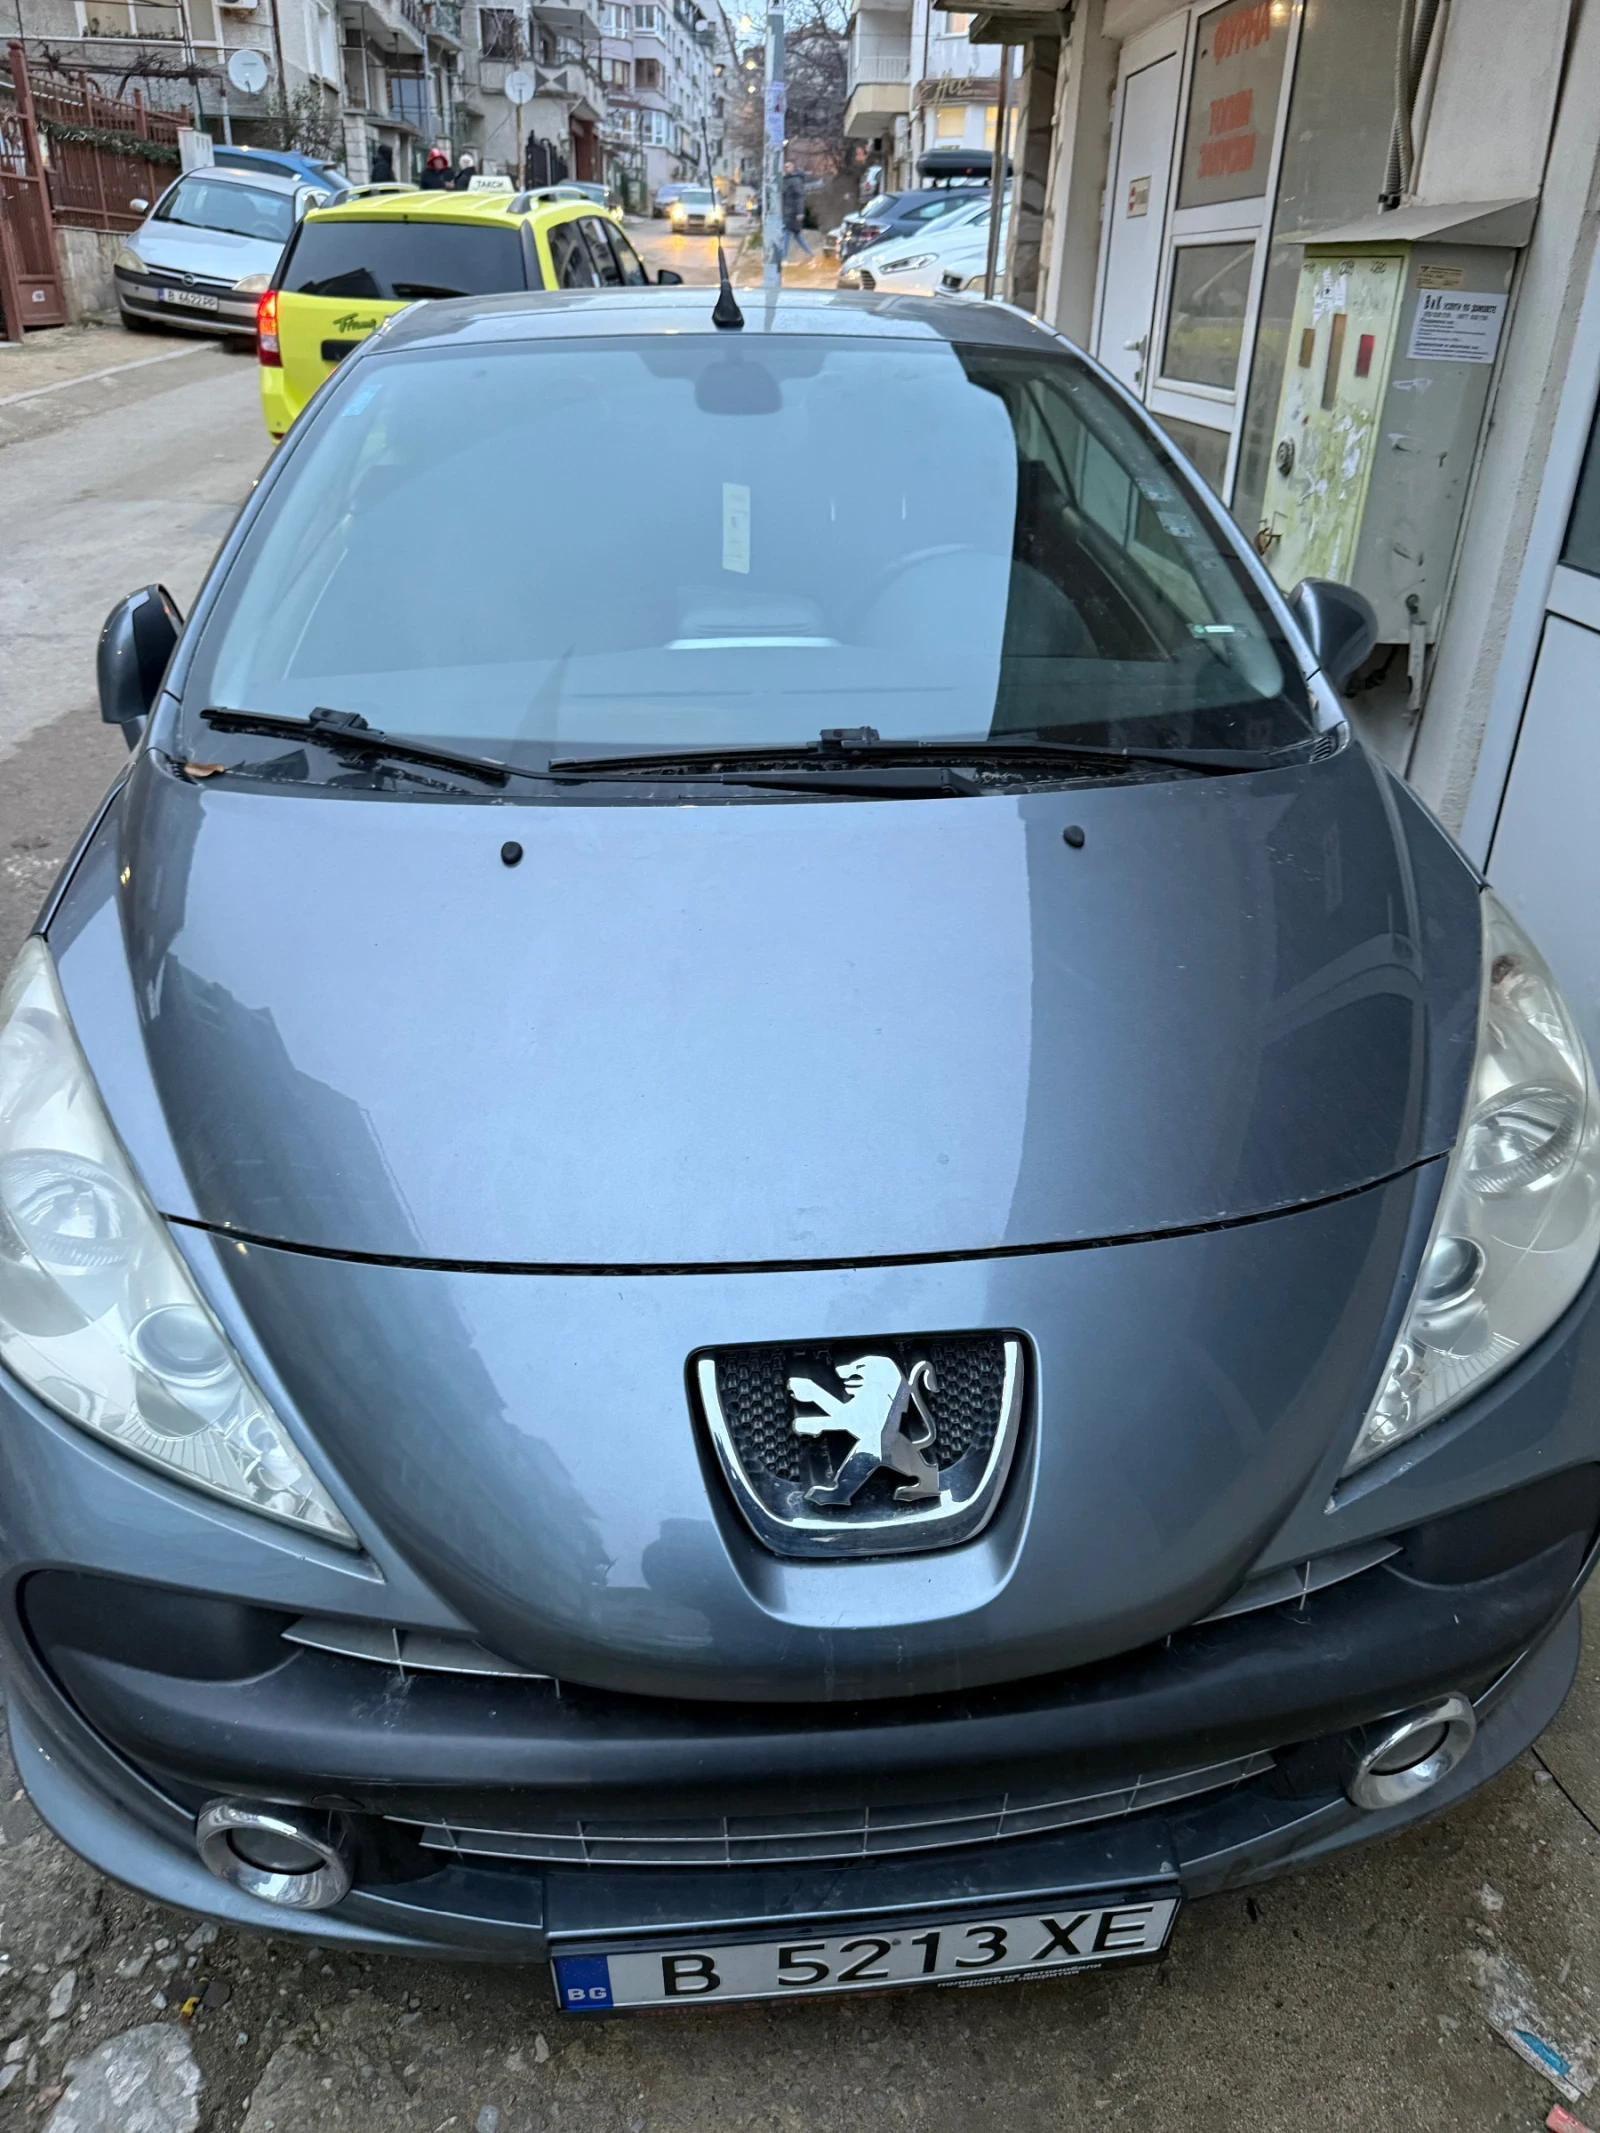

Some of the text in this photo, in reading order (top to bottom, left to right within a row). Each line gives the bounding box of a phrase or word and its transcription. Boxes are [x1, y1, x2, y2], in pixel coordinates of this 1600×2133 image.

[567, 1905, 1154, 2000] BG B 5213 XE
